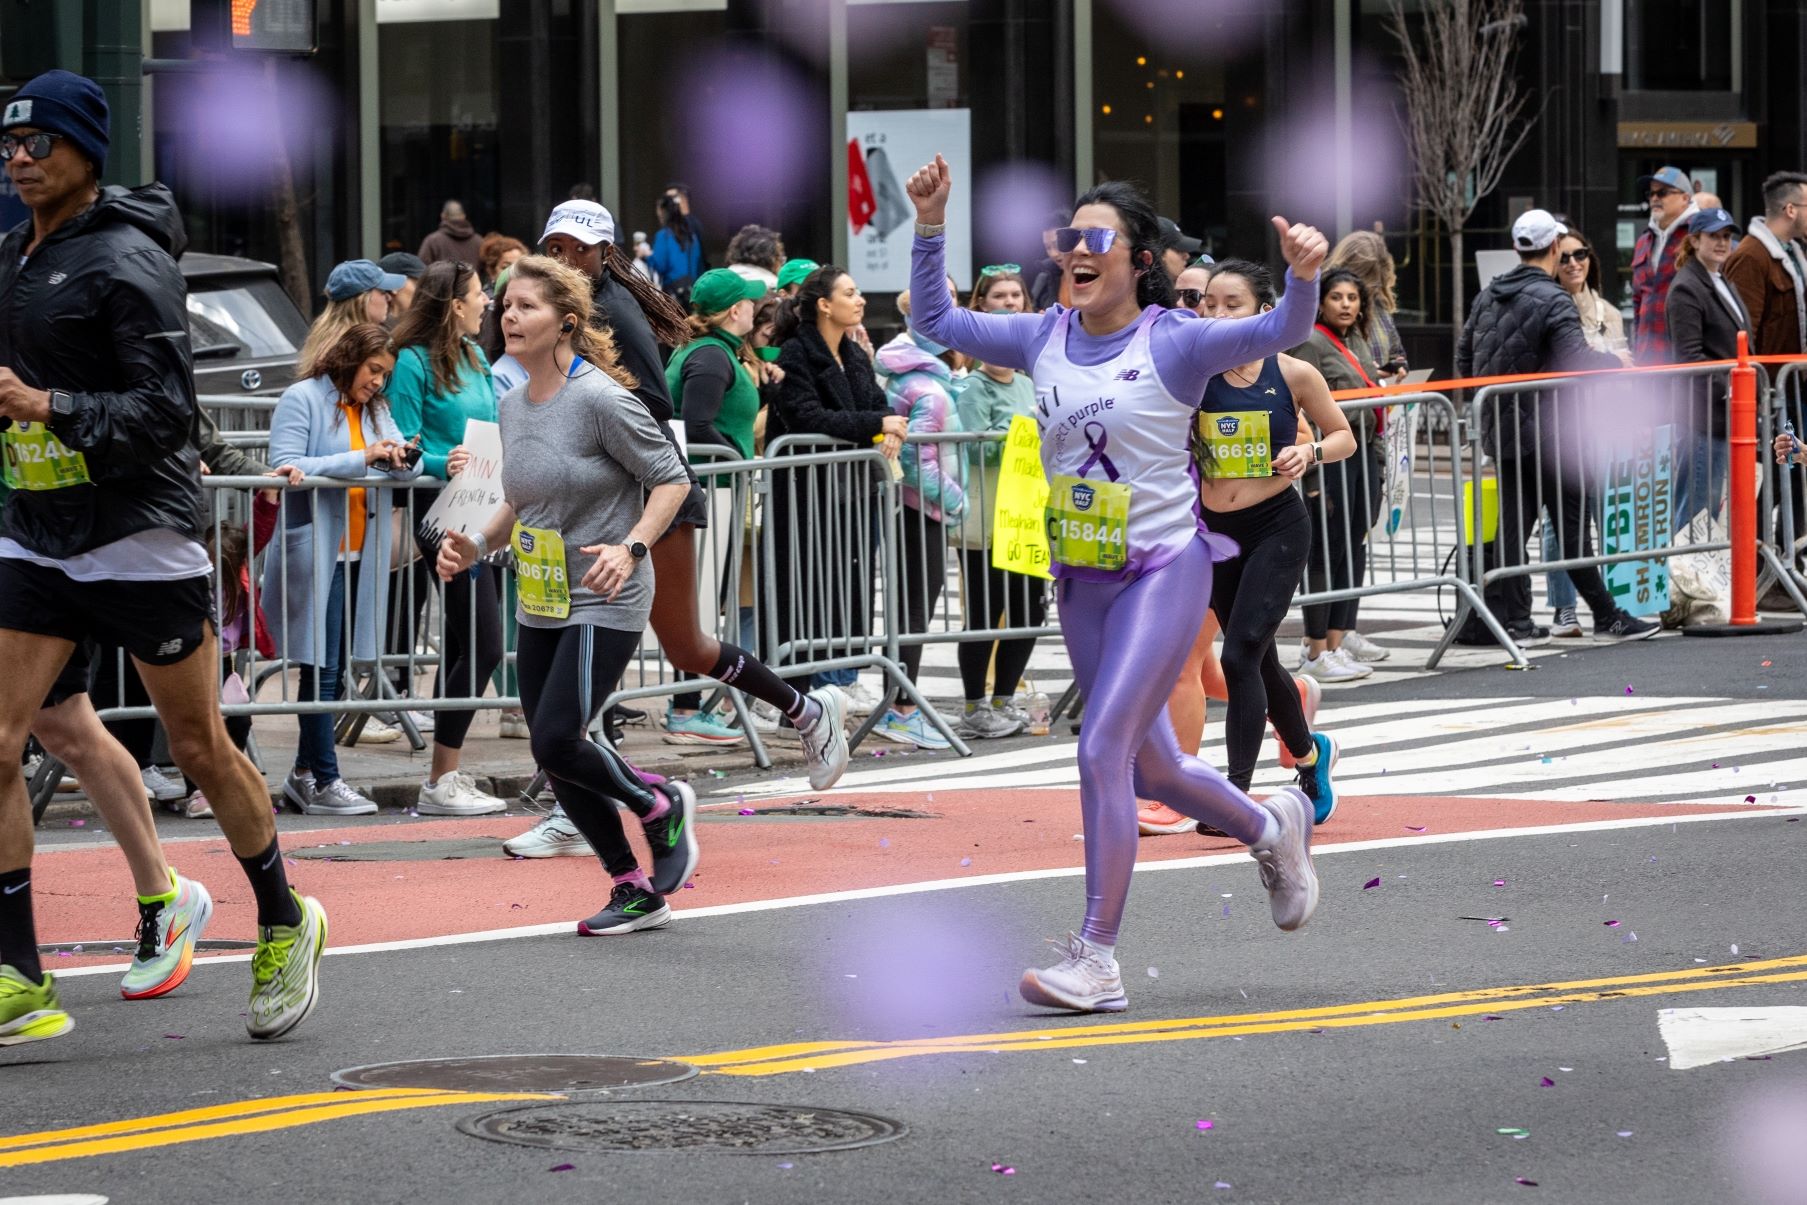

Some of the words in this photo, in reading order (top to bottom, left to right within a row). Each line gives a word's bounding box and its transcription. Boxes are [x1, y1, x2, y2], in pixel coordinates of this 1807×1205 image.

[1068, 397, 1115, 428] purple
[1209, 442, 1267, 459] 16639
[448, 488, 486, 508] FRENCH
[1074, 491, 1091, 501] NYC
[1654, 478, 1669, 535] RUN
[999, 509, 1040, 542] Meghan
[1048, 517, 1058, 541] C
[1059, 518, 1122, 546] 15844
[1007, 540, 1021, 562] GO
[517, 558, 565, 582] 20678
